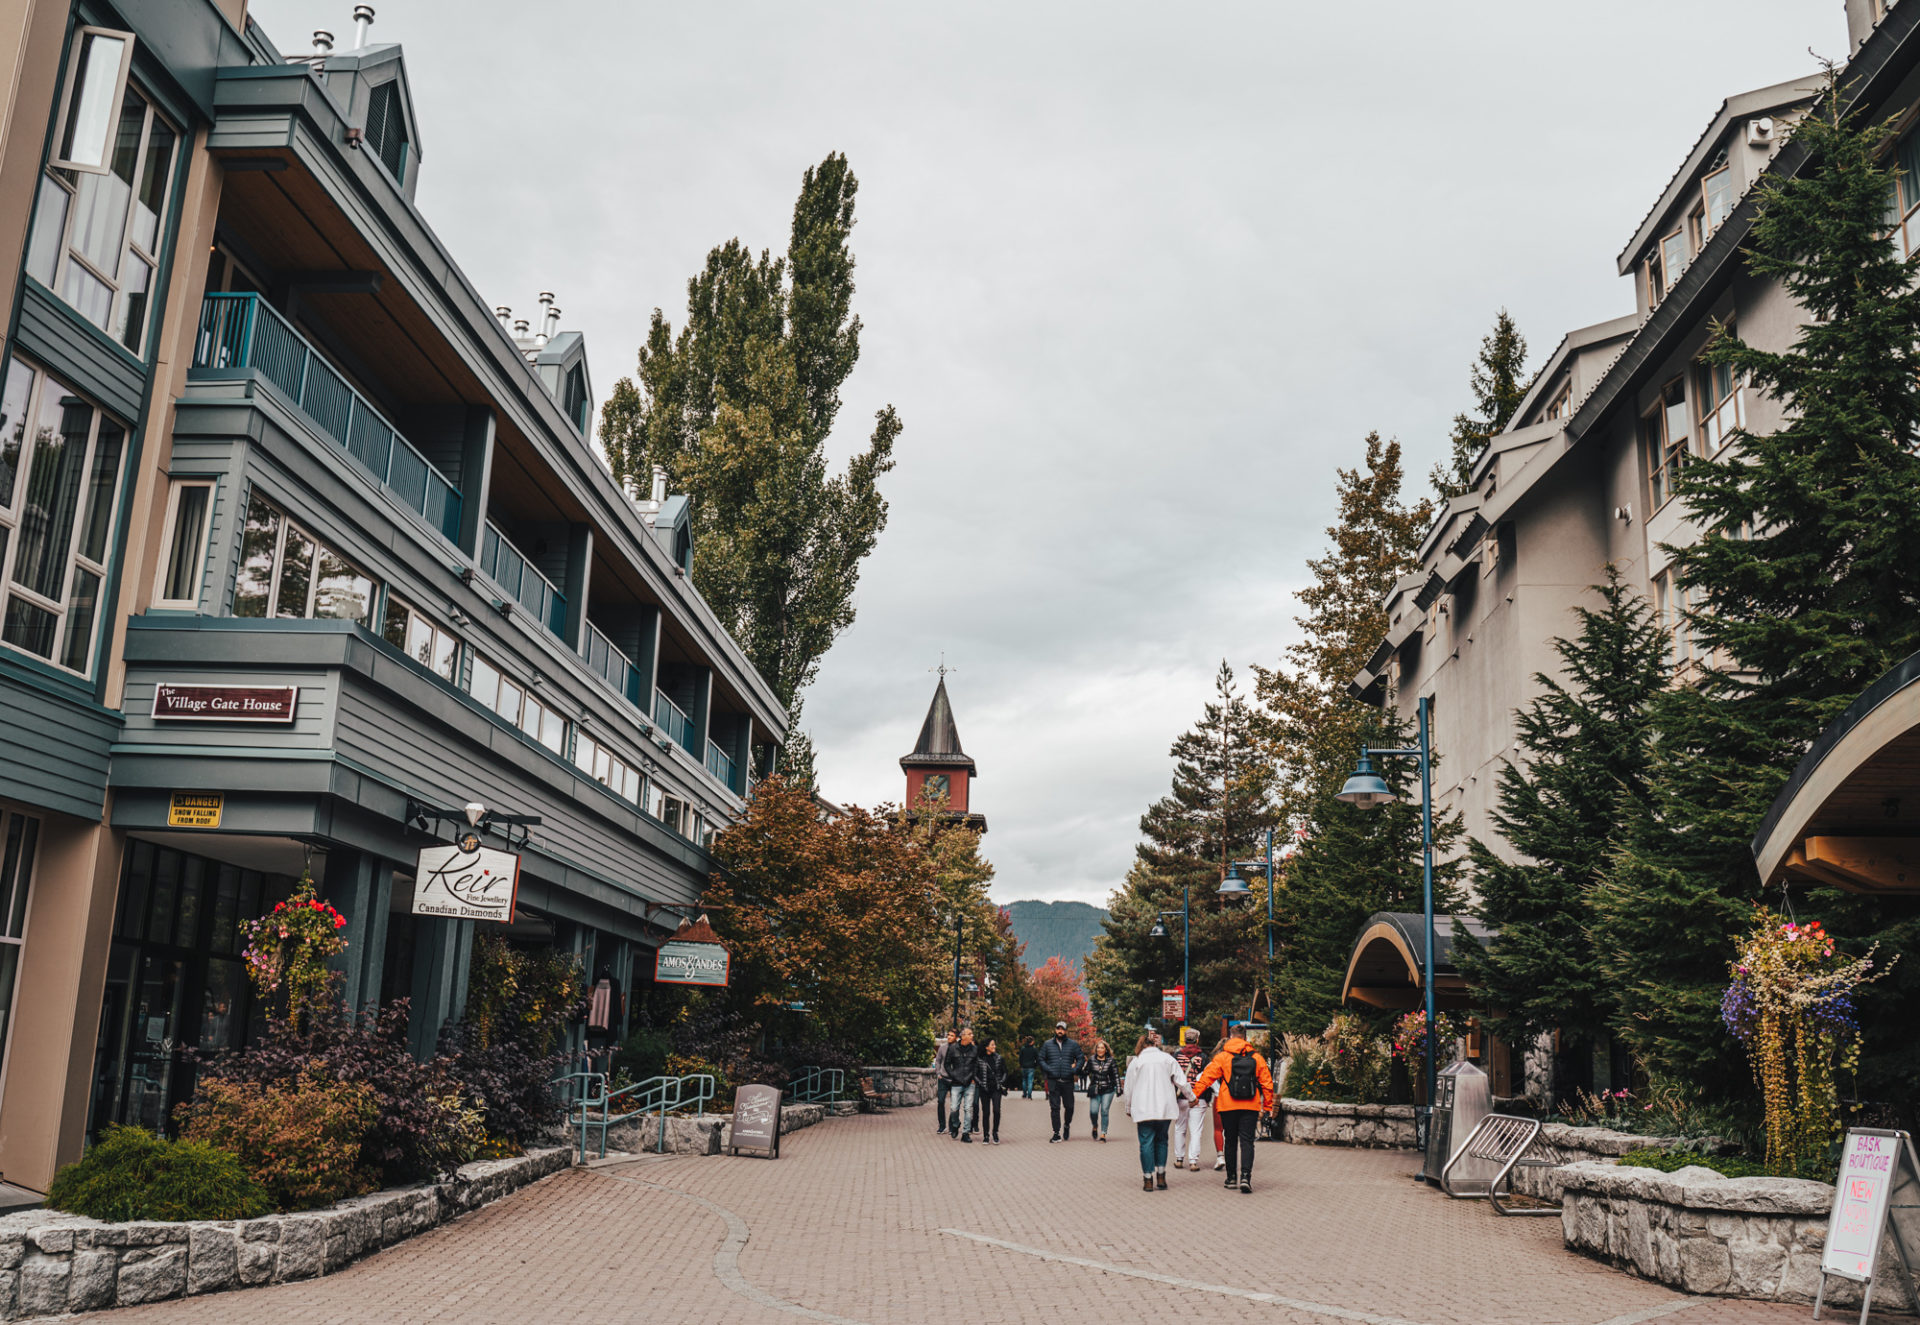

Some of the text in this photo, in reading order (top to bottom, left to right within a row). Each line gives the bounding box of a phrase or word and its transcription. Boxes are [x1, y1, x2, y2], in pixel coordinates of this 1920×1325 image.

[161, 688, 176, 696] The
[166, 696, 282, 711] Village Gate House
[185, 796, 219, 807] DANGER
[193, 809, 217, 817] FALLING
[422, 851, 508, 908] Keir
[466, 893, 508, 905] Fine Jewellery
[418, 903, 503, 918] Canadian Diamonds
[1857, 1136, 1882, 1152] BASK
[1848, 1153, 1890, 1172] BOUTIQUE
[1850, 1180, 1875, 1200] NEW
